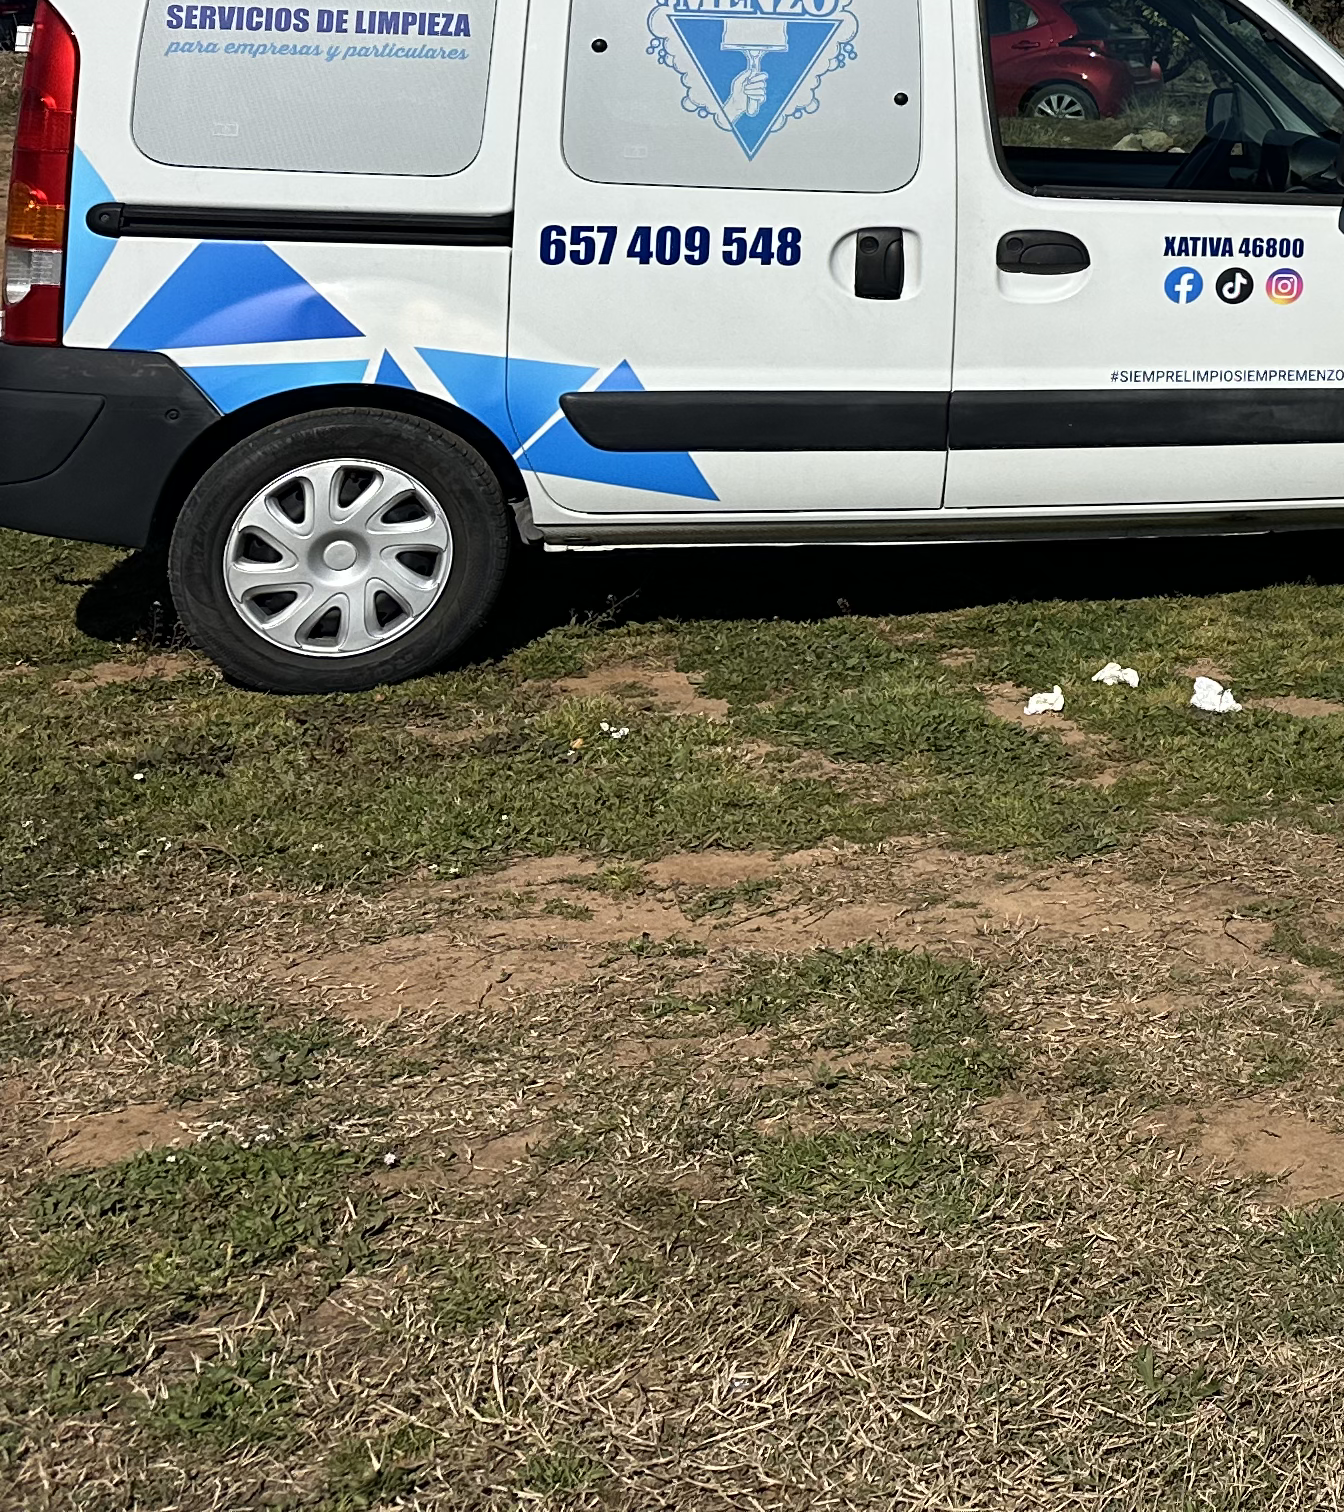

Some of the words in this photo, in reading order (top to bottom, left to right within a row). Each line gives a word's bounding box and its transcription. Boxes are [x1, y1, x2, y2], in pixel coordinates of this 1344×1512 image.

[166, 4, 309, 33] SERVICIOS
[317, 9, 348, 33] DE
[355, 10, 471, 37] LIMPIEZA
[164, 39, 219, 56] para
[224, 42, 324, 58] empresas
[323, 44, 342, 62] y
[342, 43, 469, 61] particulares
[540, 224, 618, 265] 657
[627, 225, 710, 265] 409
[722, 227, 801, 266] 548
[1163, 236, 1234, 257] XATIVA
[1239, 238, 1304, 258] 46800
[1111, 369, 1344, 383] #SIEMPRELIMPIOSIEMPREMENZO
